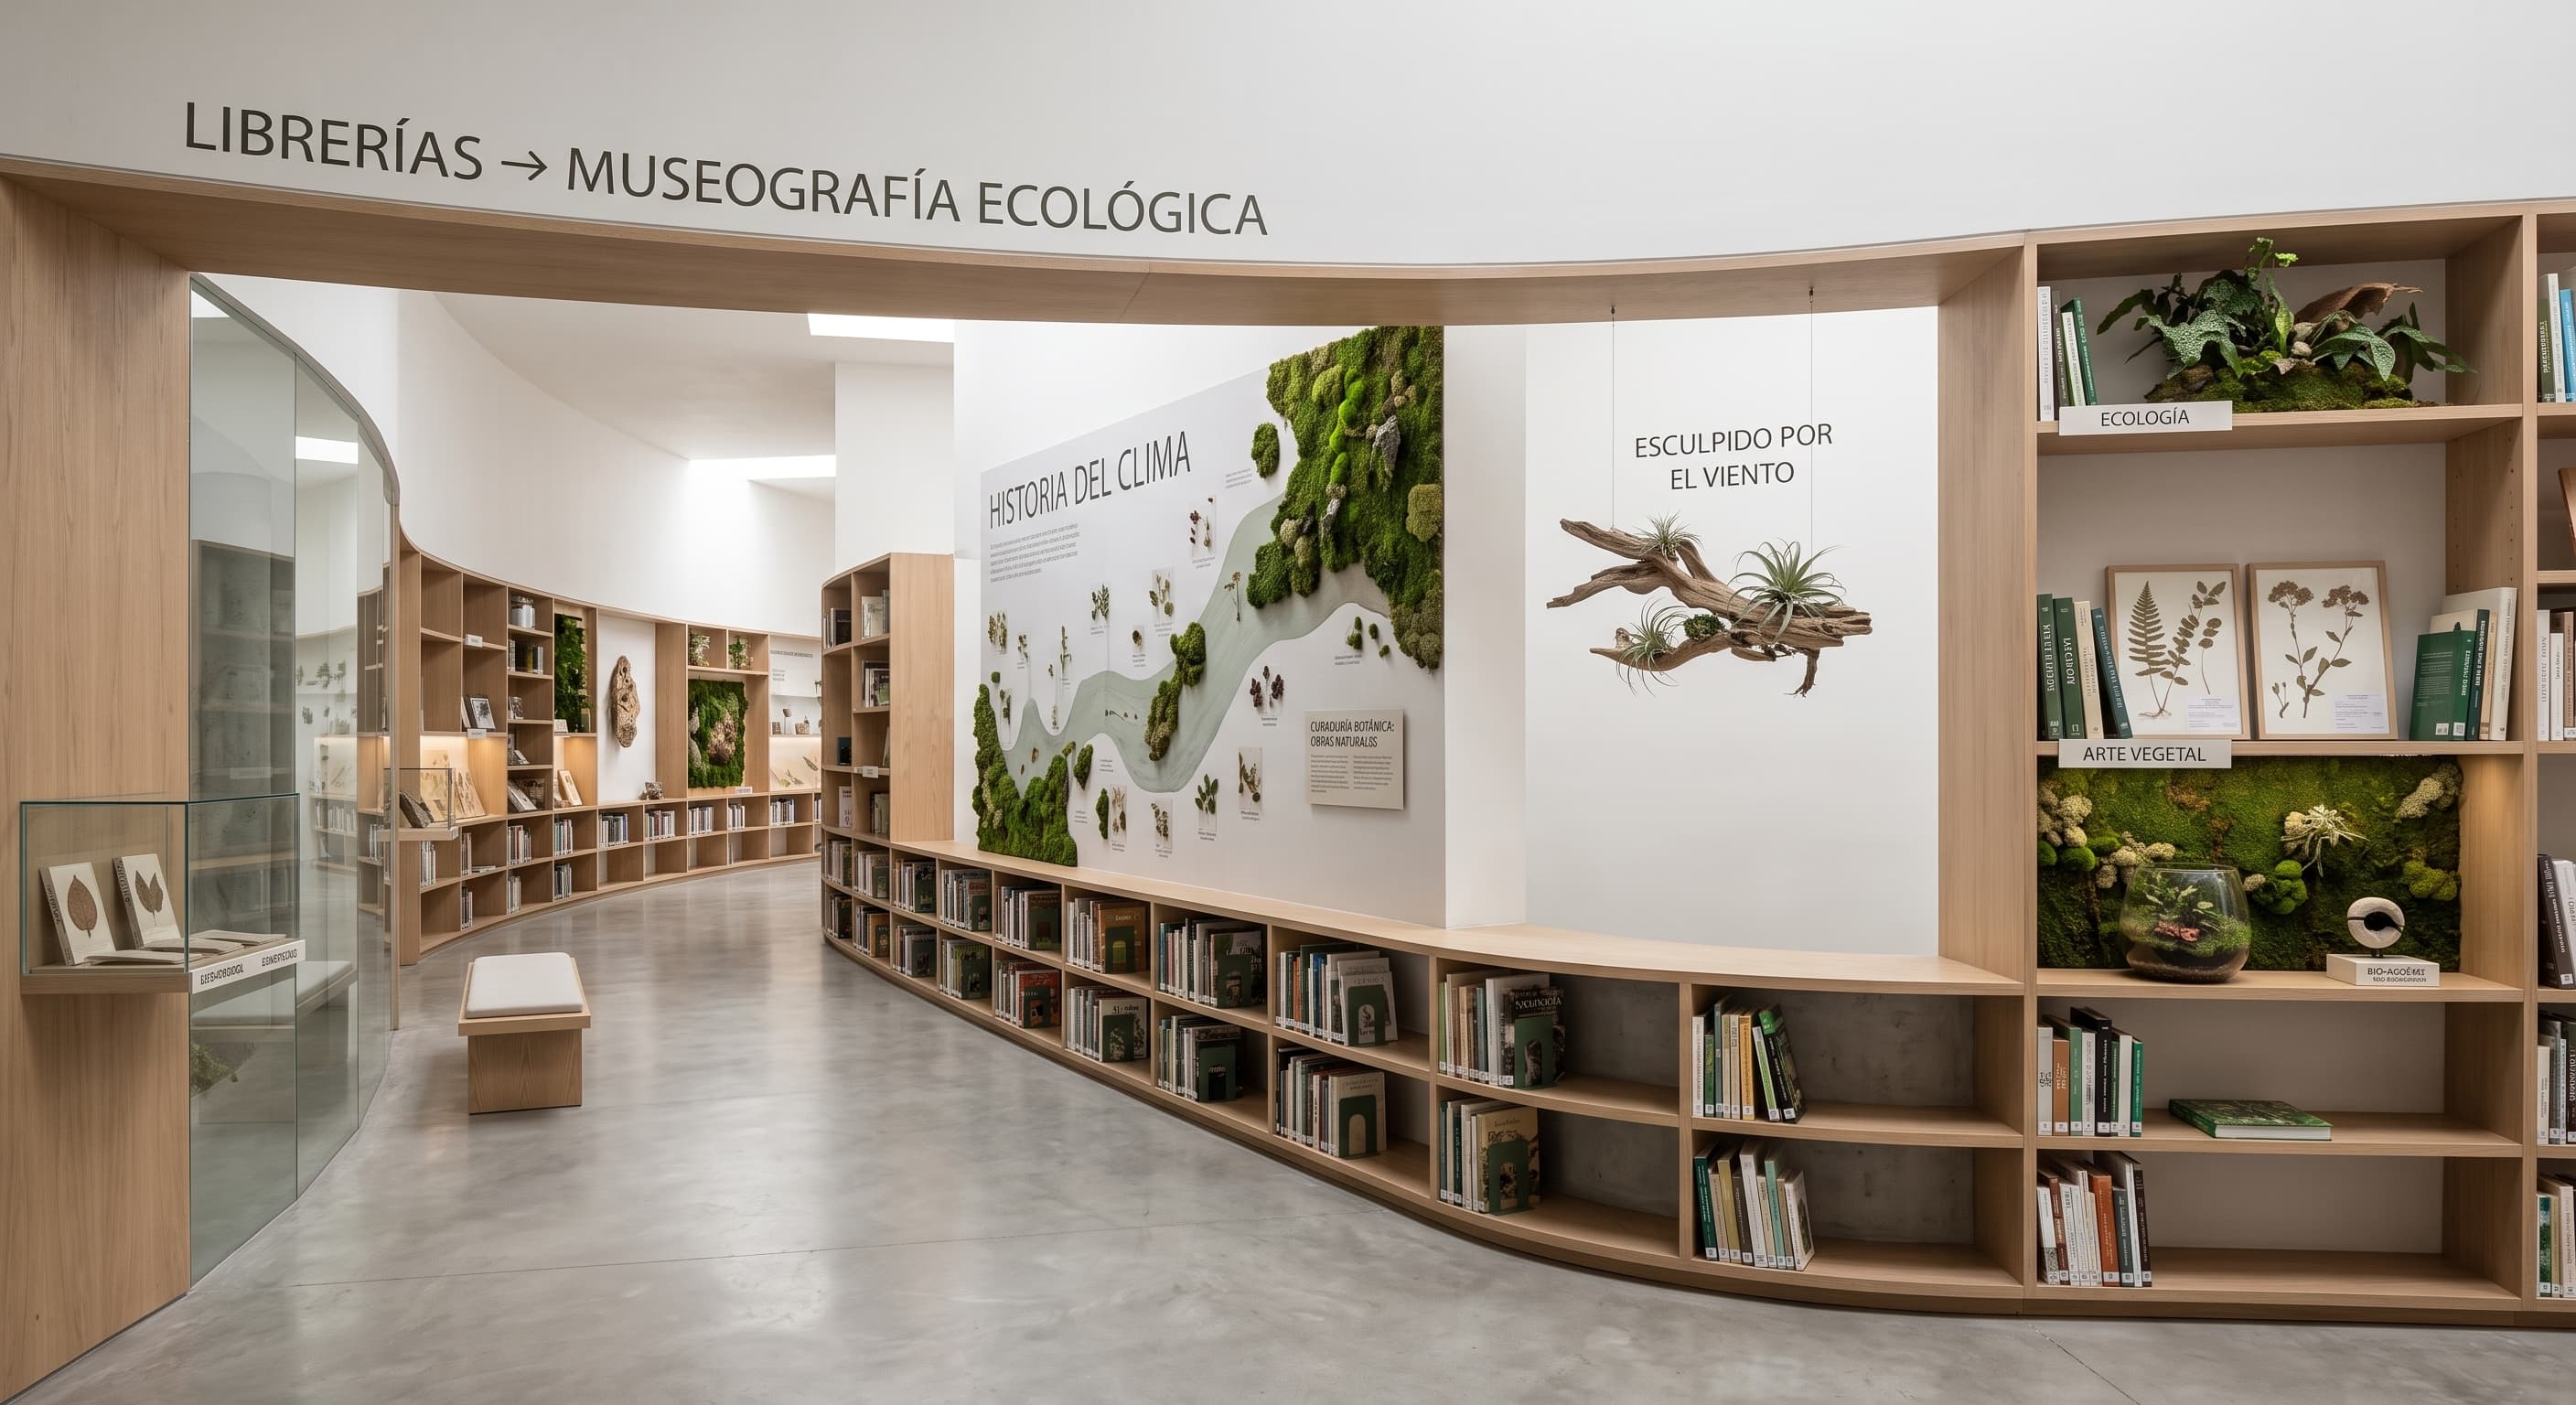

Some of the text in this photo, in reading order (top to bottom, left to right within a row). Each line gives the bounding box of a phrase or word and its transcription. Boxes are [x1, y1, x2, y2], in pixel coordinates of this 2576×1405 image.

[185, 102, 1269, 236] LIBRERÍAS MUSEOGRAFÍA ECOLÓGICA
[2100, 406, 2190, 427] ECOLOGÍA
[1635, 423, 1833, 458] ESCULPIDO POR
[990, 431, 1191, 530] HISTORIA DEL CLIMA
[1670, 461, 1795, 490] EL VIENTO
[1310, 718, 1395, 733] CURADURÍA BOTÁNICA:
[1310, 735, 1335, 747] OBRAS
[2083, 746, 2207, 762] ARTE VEGETAL
